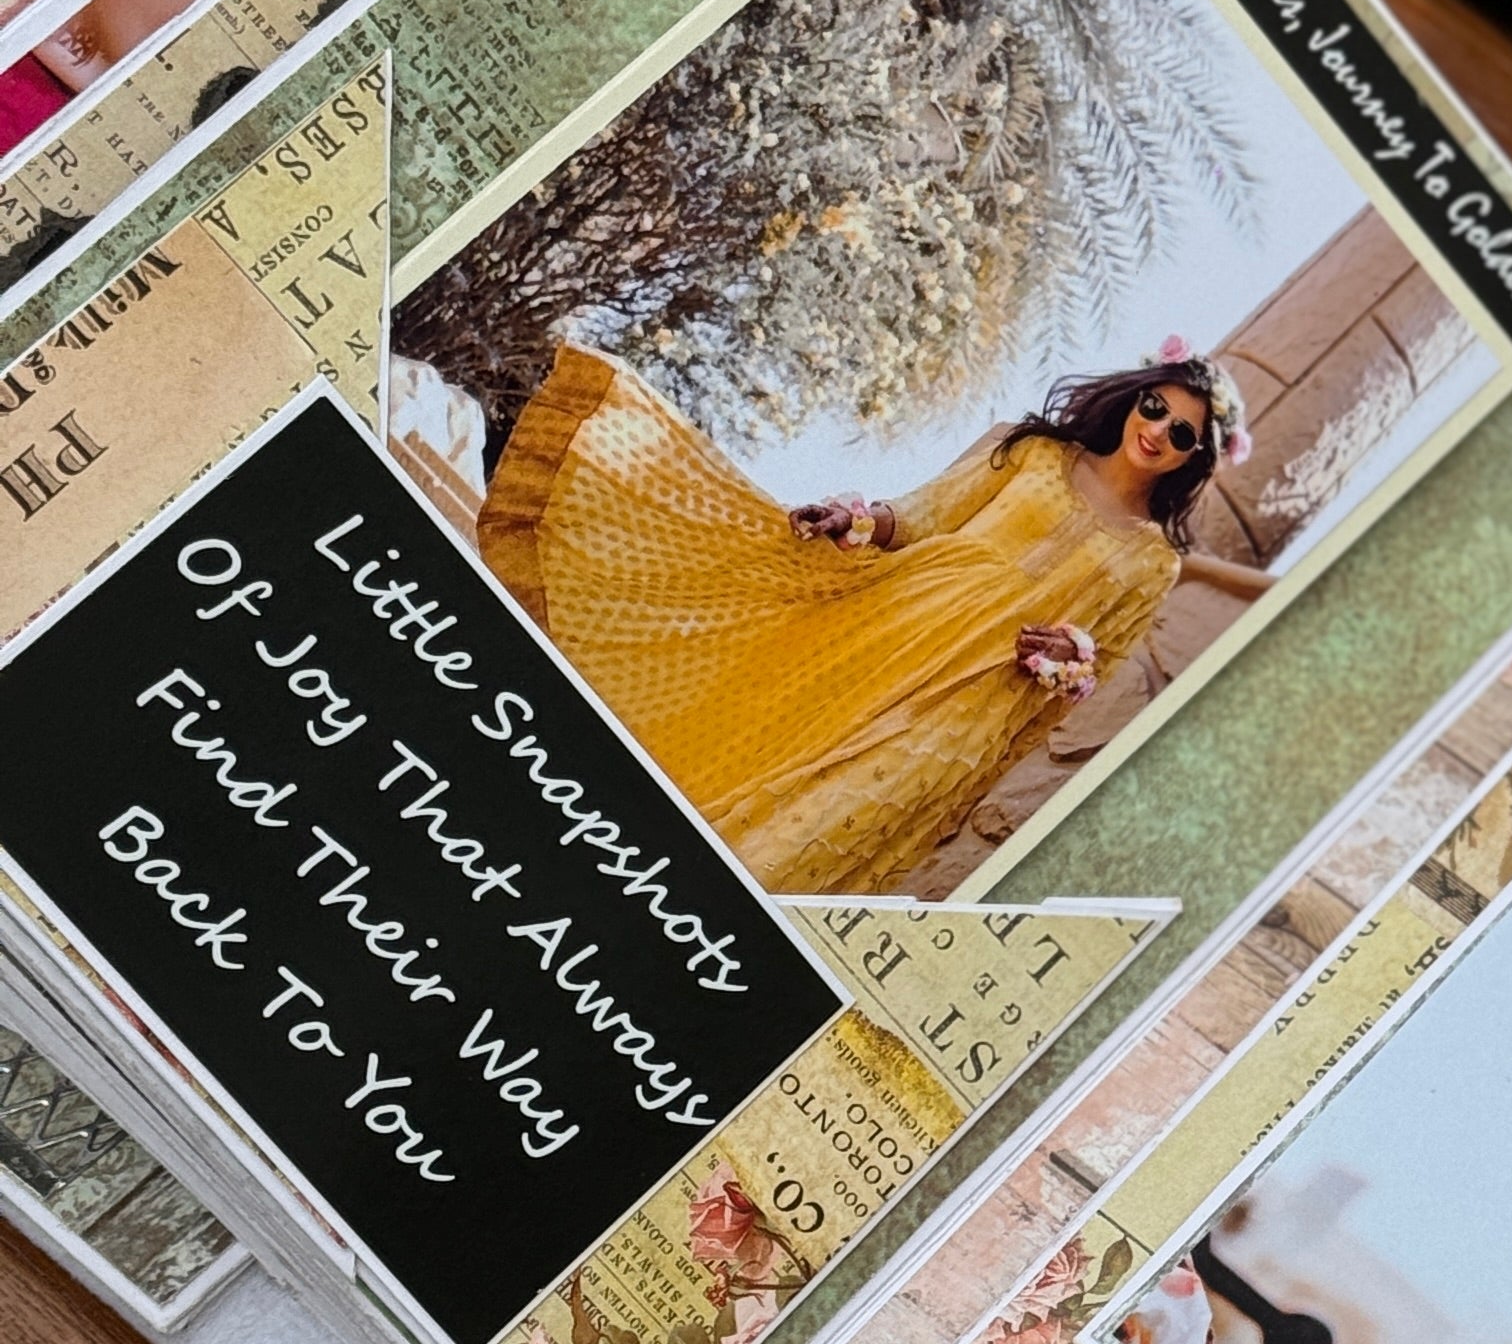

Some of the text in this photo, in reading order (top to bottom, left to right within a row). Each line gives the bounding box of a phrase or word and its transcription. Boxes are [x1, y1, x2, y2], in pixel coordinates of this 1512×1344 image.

[1308, 23, 1415, 160] Journey
[1414, 140, 1455, 198] To
[137, 669, 298, 827] Find
[296, 827, 456, 1005] Their
[460, 1008, 580, 1158] Way
[177, 538, 273, 620] Of
[255, 634, 368, 747] Joy
[379, 740, 522, 902] That
[507, 917, 717, 1128] Always
[313, 514, 749, 993] Little Snapshots
[98, 806, 456, 1182] Back To You
[779, 1073, 897, 1204] TORONTO
[845, 1092, 914, 1176] COLO.
